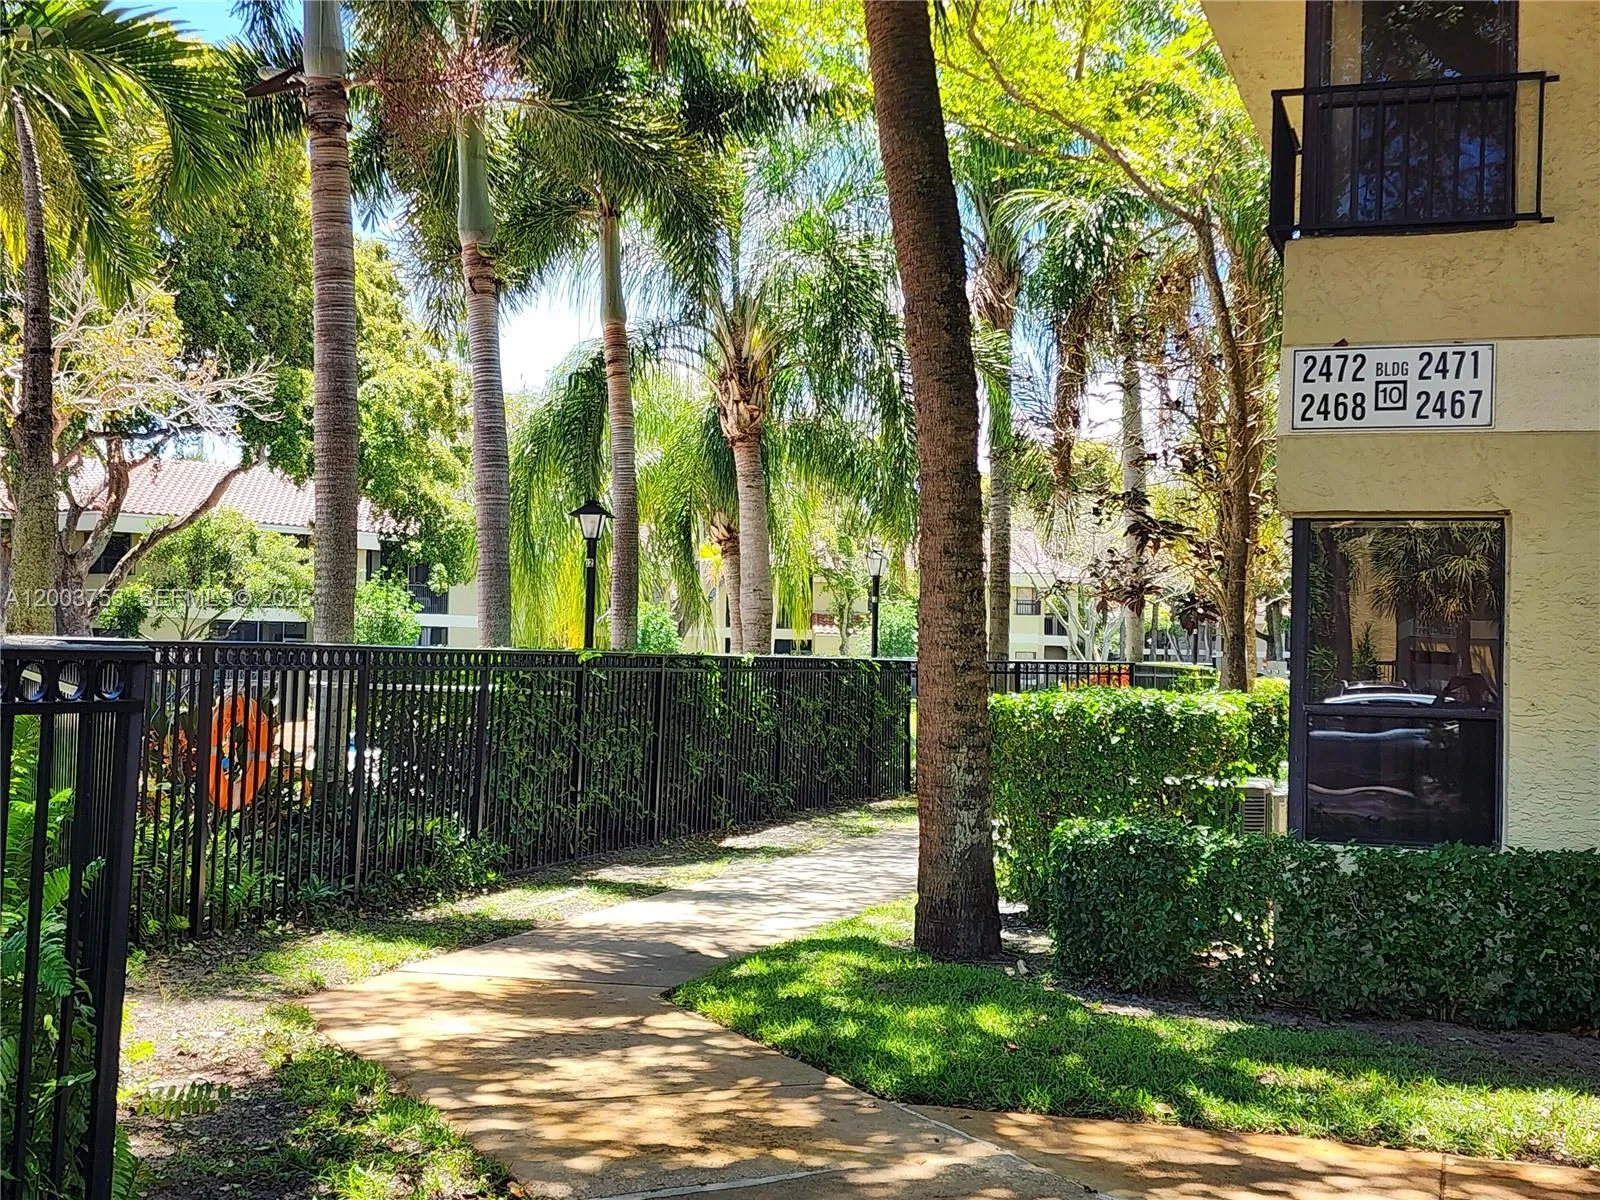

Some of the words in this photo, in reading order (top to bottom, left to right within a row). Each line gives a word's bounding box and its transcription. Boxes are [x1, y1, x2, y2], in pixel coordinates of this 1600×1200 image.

[1302, 353, 1367, 383] 2472
[1375, 361, 1409, 377] BLDG
[1418, 350, 1480, 381] 2471
[1300, 392, 1366, 422] 2468
[1379, 386, 1402, 405] 10
[1415, 390, 1483, 420] 2467
